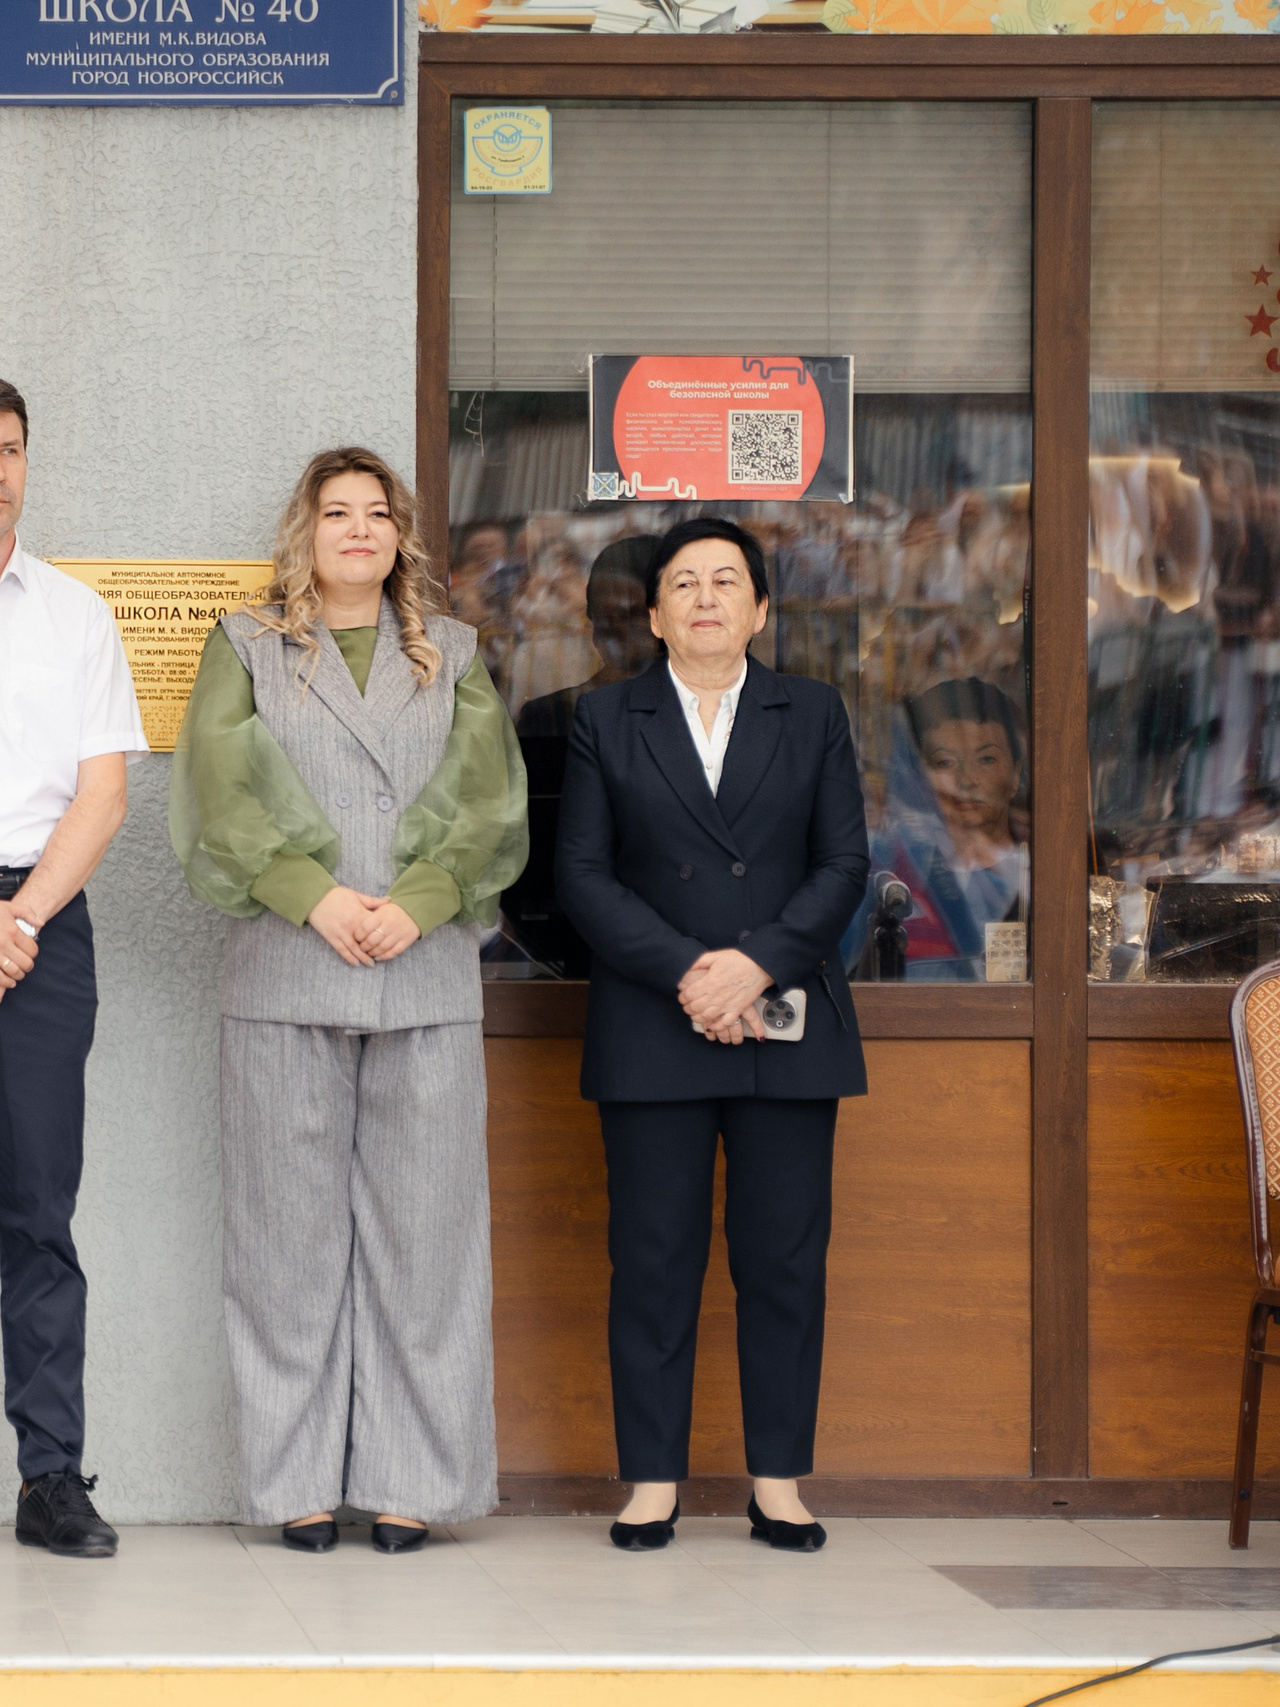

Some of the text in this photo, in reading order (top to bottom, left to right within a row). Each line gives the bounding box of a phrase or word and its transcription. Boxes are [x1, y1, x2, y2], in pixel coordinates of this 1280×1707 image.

[39, 0, 319, 23] ШКОЛА № 40
[89, 32, 267, 47] ИМЕНИ М.К.ВИДОВА
[26, 52, 330, 68] МУНИЦИПАЛЬНОГО ОБРАЗОВАНИЯ
[72, 70, 284, 86] ГОРОД НОВОРОССИЙСК
[473, 111, 542, 130] ОХРАНЯЕТСЯ
[472, 166, 543, 187] РОСГВАРДИЯ
[647, 380, 789, 391] Объединённые усилия для
[669, 390, 770, 399] безопасной школы
[98, 578, 240, 587] ОБЩЕОБРАЗОВАТЕЛЬНОЕ УЧРЕЖДЕНИЕ
[97, 590, 266, 601] НЯЯ ОБЩЕОБРАЗОВАТЕЛЬН
[115, 606, 183, 621] ШКОЛА
[122, 626, 156, 634] ИМЕНИ
